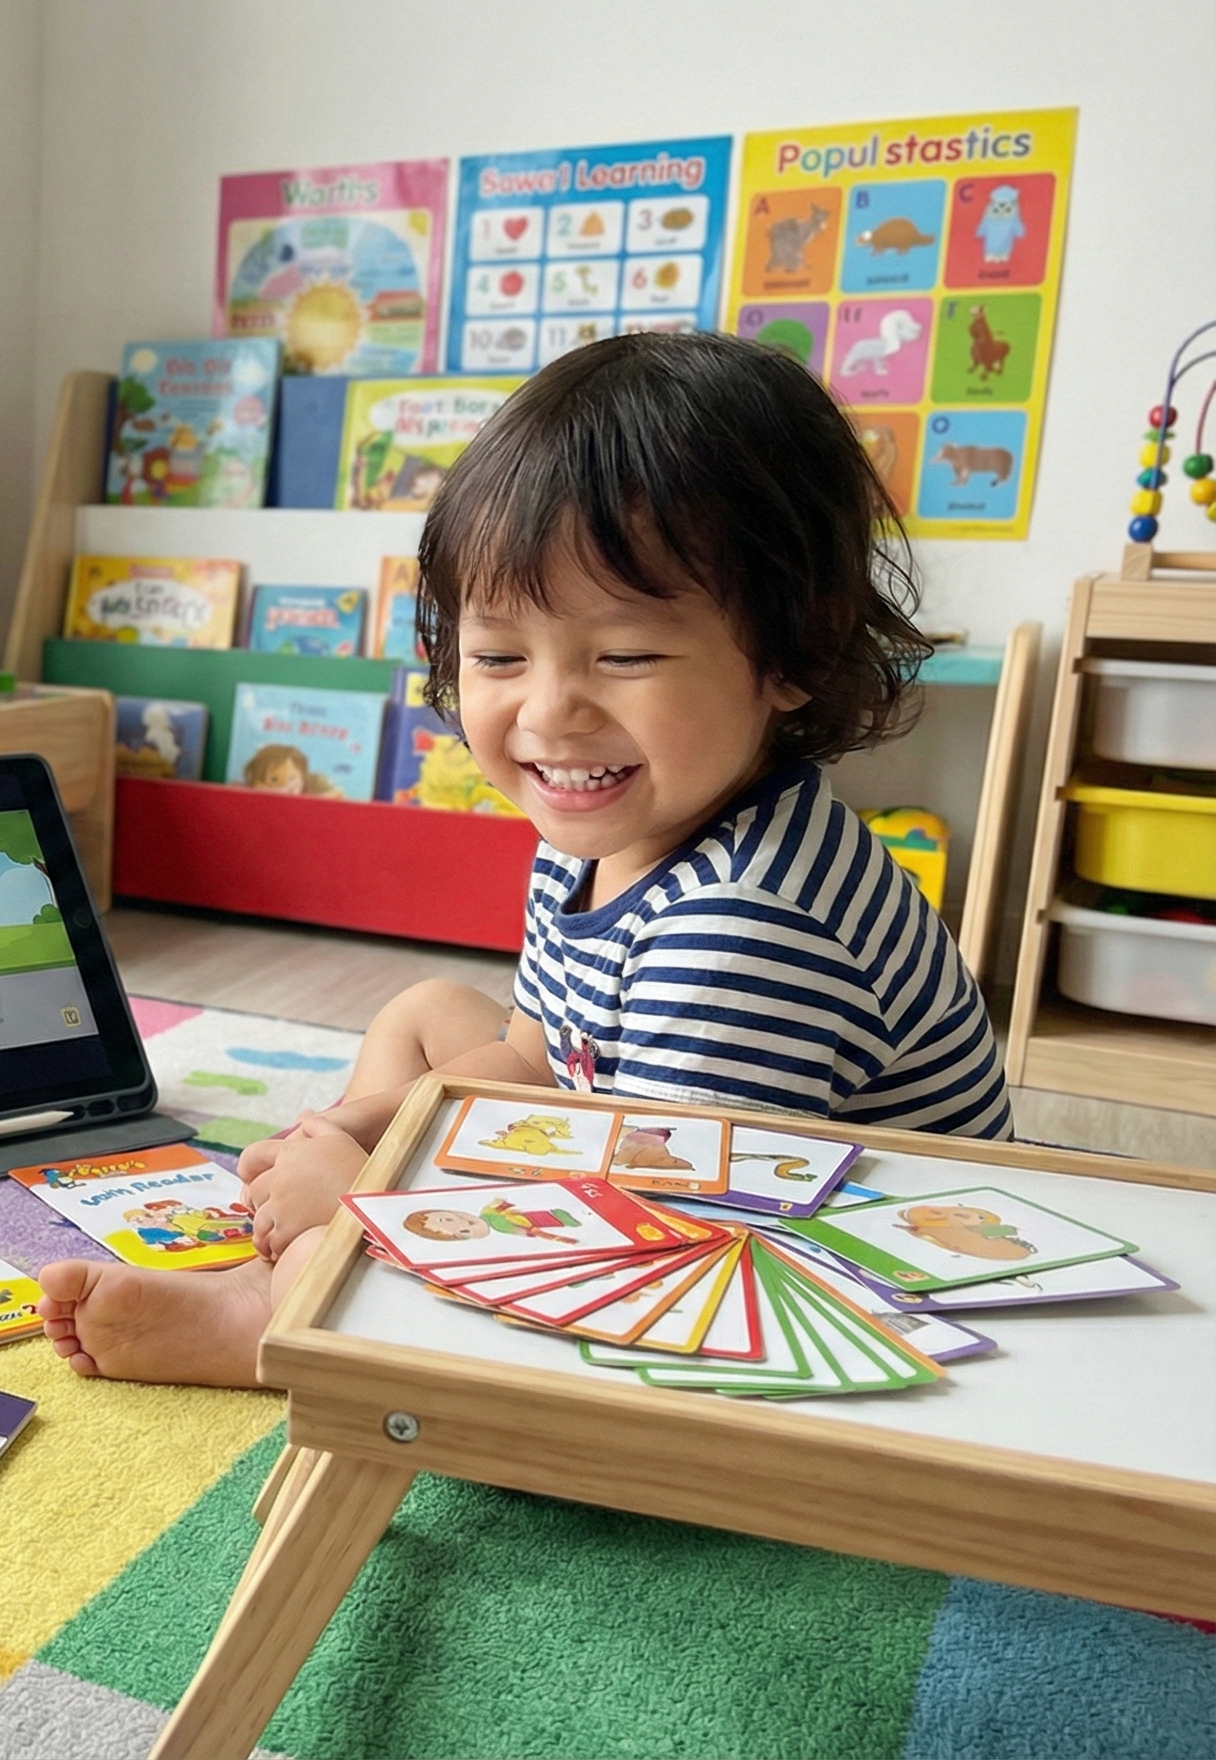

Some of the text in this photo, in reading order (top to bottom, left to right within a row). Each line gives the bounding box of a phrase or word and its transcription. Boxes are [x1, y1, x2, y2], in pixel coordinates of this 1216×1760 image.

[778, 127, 1031, 178] Popul stastics
[578, 153, 704, 189] Learning
[855, 191, 870, 209] B
[958, 183, 975, 204] C
[753, 197, 770, 216] A
[557, 213, 572, 237] 2
[638, 208, 652, 231] 3
